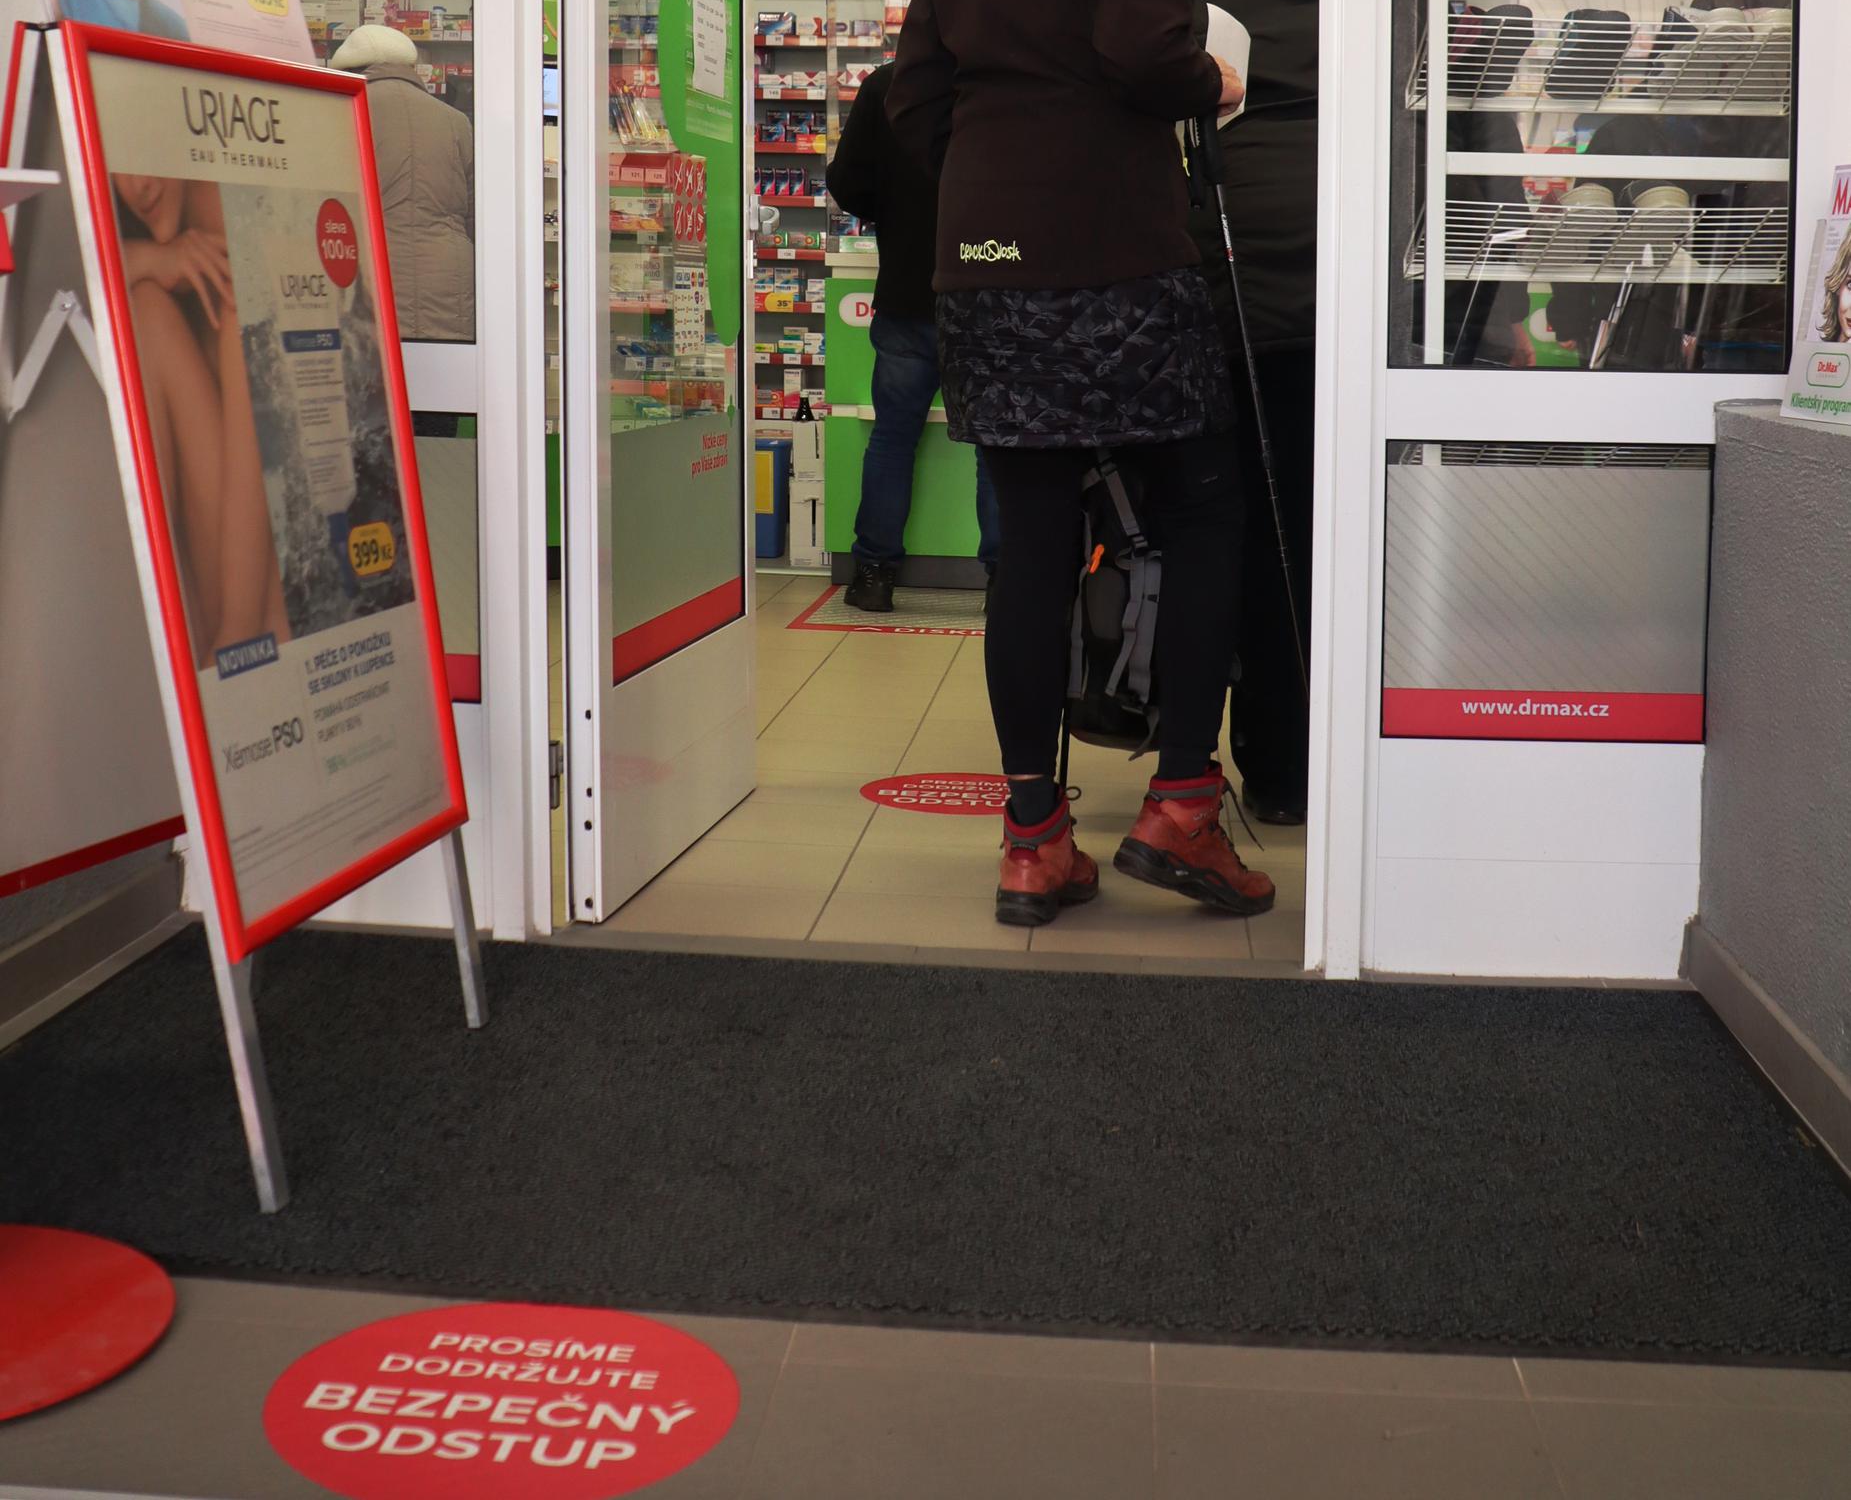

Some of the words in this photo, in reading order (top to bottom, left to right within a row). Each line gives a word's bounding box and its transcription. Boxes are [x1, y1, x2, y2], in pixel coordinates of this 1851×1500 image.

[182, 86, 285, 148] URIAGE
[191, 149, 216, 163] EAU
[325, 219, 347, 234] sleva
[322, 238, 344, 260] 100
[280, 275, 329, 298] URIAGE
[1817, 361, 1838, 373] Dr.Max
[352, 539, 379, 568] 399
[380, 544, 393, 561] Kč
[218, 637, 275, 674] NOVINKA
[1461, 698, 1610, 718] www.drmax.cz
[271, 716, 304, 752] PSO
[878, 788, 1011, 800] BEZPEČ
[903, 783, 1011, 792] DODRŽUJ
[893, 797, 1006, 807] ODSTU
[429, 1331, 637, 1364] PROSÍME
[378, 1352, 660, 1391] DODRŽUJTE
[303, 1380, 698, 1435] BEZPEČNÝ
[320, 1420, 638, 1470] ODSTUP
